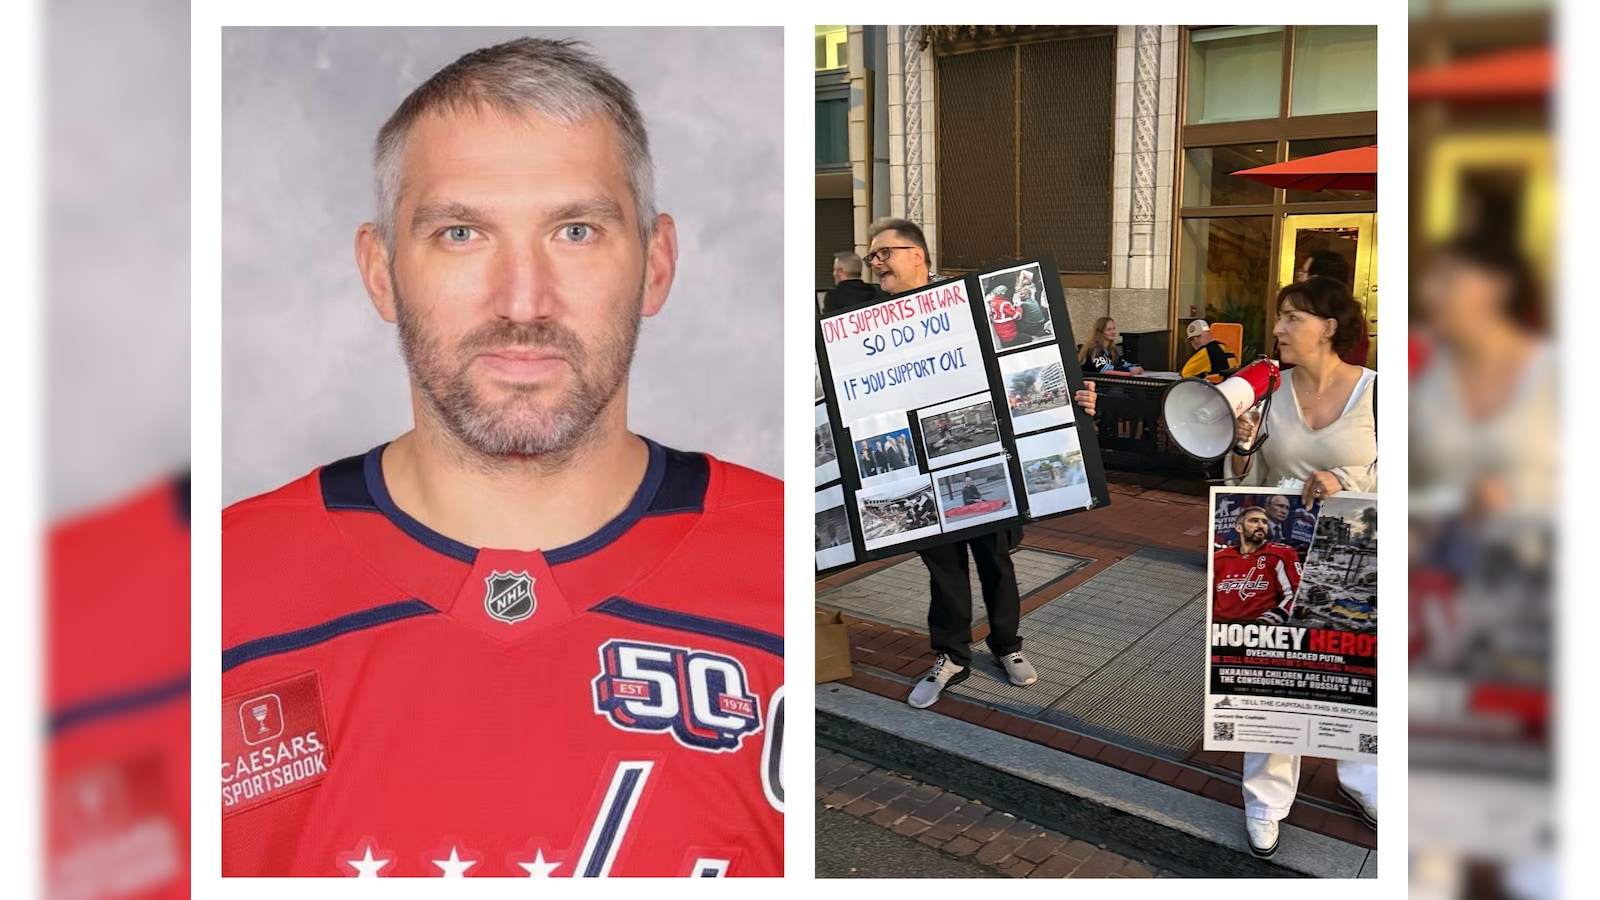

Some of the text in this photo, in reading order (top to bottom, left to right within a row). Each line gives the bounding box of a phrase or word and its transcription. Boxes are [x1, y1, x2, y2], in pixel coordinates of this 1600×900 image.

[823, 285, 966, 343] OVI SUPPORTS THE WAR
[863, 312, 951, 356] SO DO YOU
[843, 347, 967, 401] IF YOU SUPPORT OVI
[1256, 555, 1266, 570] C
[495, 583, 526, 613] NHL
[1211, 623, 1308, 651] HOCKEY
[1246, 649, 1346, 665] OVECHKIN BACKED PUTIN.
[613, 644, 752, 733] 50
[619, 682, 644, 696] EST
[1219, 668, 1373, 688] UKRAINIAN CHILDREN ARE LIVING WITH
[1220, 676, 1236, 684] THE
[1236, 676, 1296, 688] CONSEQUENCES
[1296, 680, 1308, 688] OF
[1309, 681, 1347, 692] RUSSIA'S
[1348, 685, 1372, 696] WAR.
[723, 698, 750, 713] 1974
[222, 752, 327, 806] SPORTSBOOK
